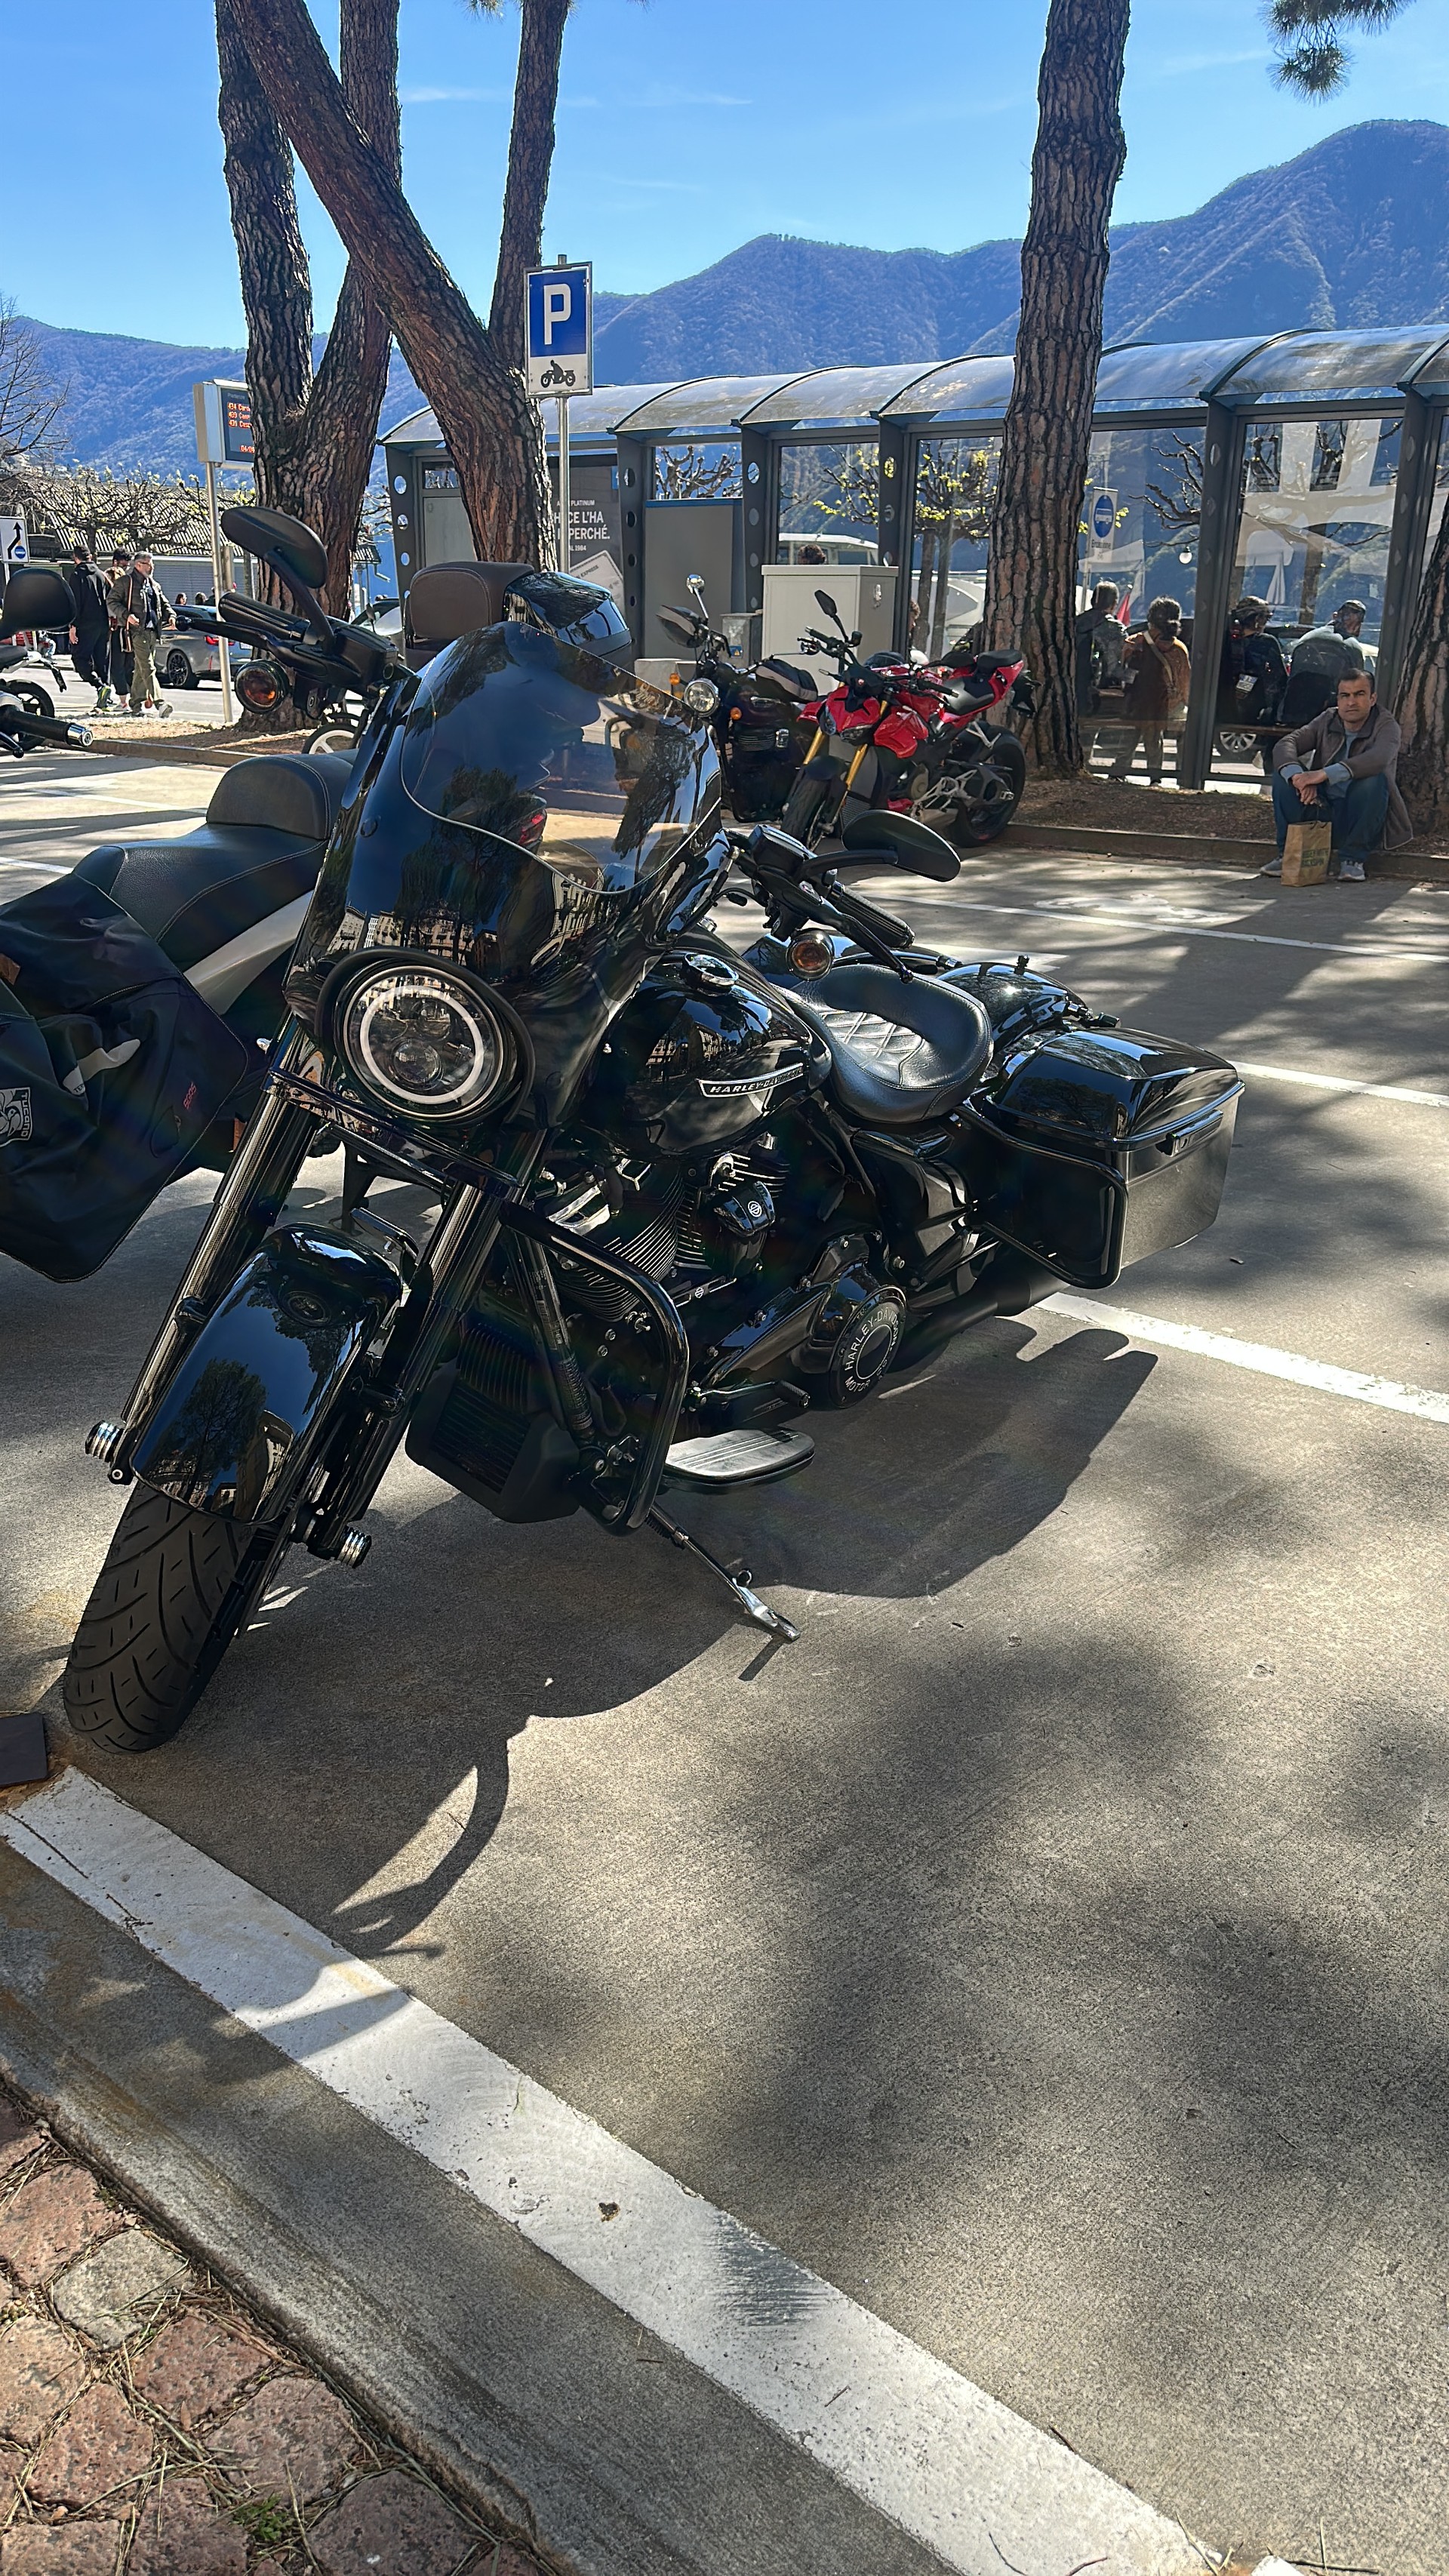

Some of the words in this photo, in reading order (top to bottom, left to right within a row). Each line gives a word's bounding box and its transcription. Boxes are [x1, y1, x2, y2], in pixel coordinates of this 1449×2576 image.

[544, 283, 571, 345] P
[582, 511, 604, 524] L'HA
[568, 524, 611, 540] PERCHÉ.
[844, 1306, 899, 1371] HARLEY-DAVIDSON
[844, 1375, 870, 1393] MOTOR
